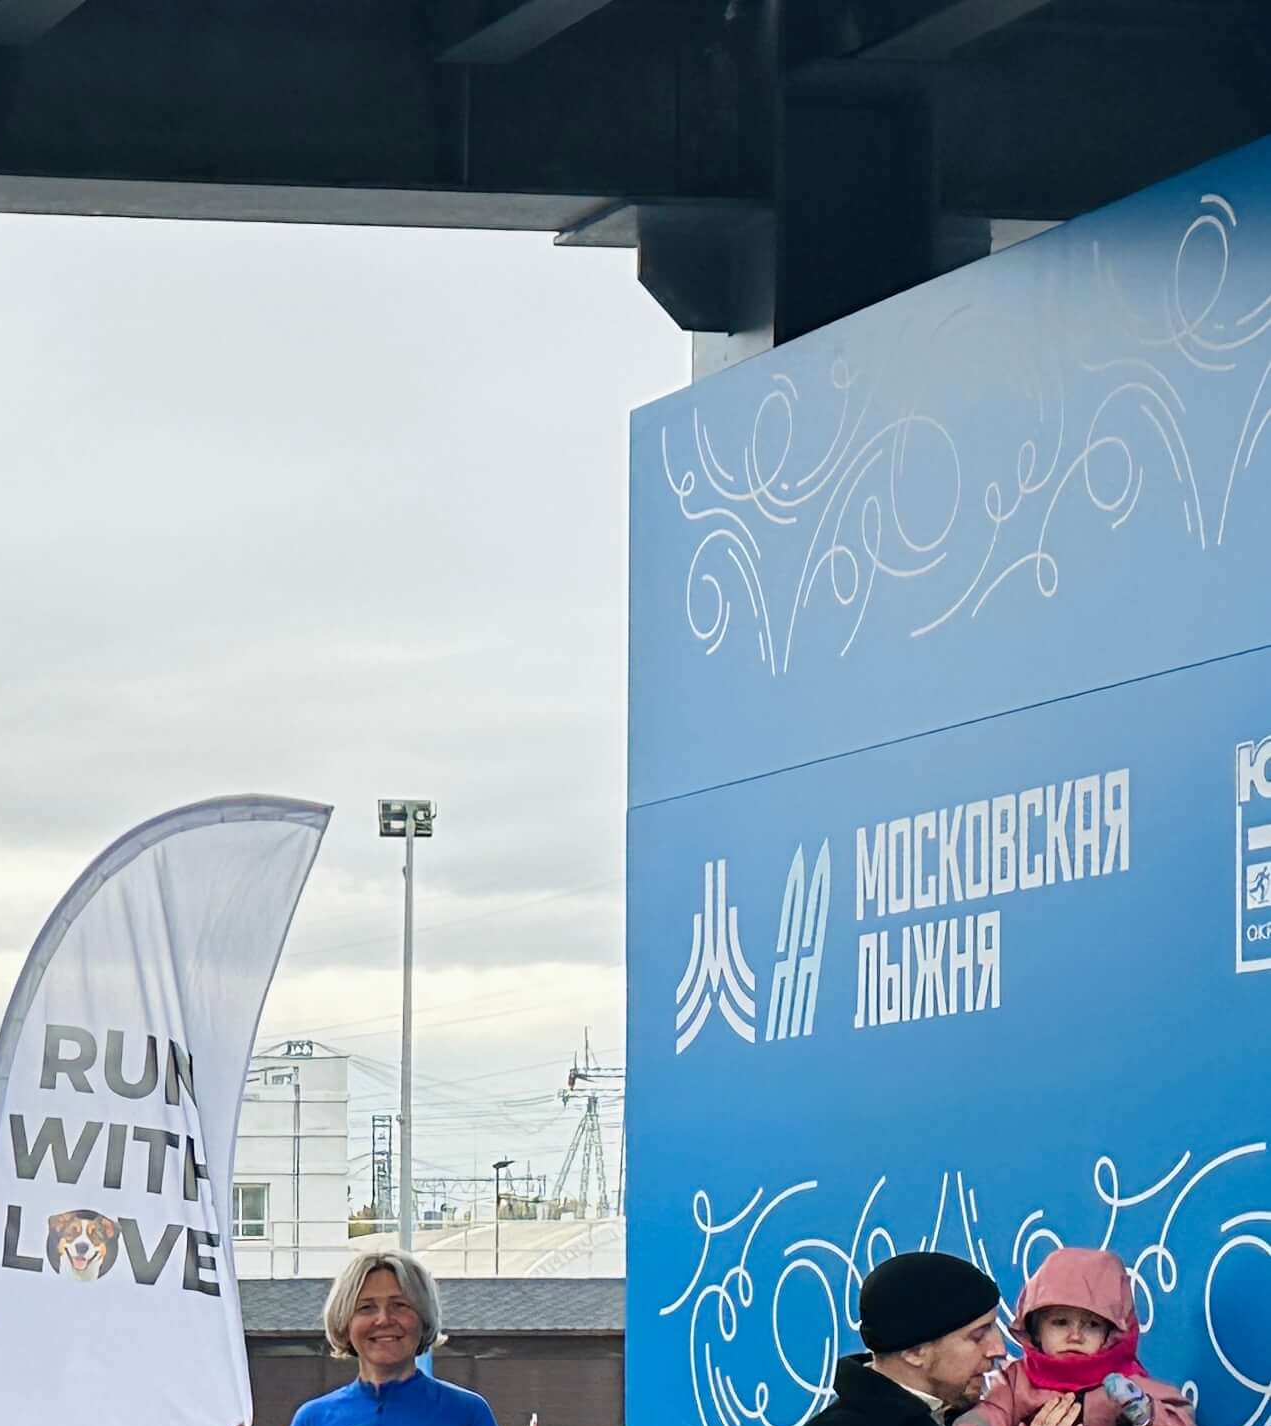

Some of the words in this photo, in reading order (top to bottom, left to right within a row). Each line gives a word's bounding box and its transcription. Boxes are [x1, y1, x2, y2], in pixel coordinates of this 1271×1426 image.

[856, 767, 1130, 921] МОСКОВСКАЯ
[854, 910, 1002, 1030] ЛЫЖНЯ
[39, 1023, 199, 1108] RUN
